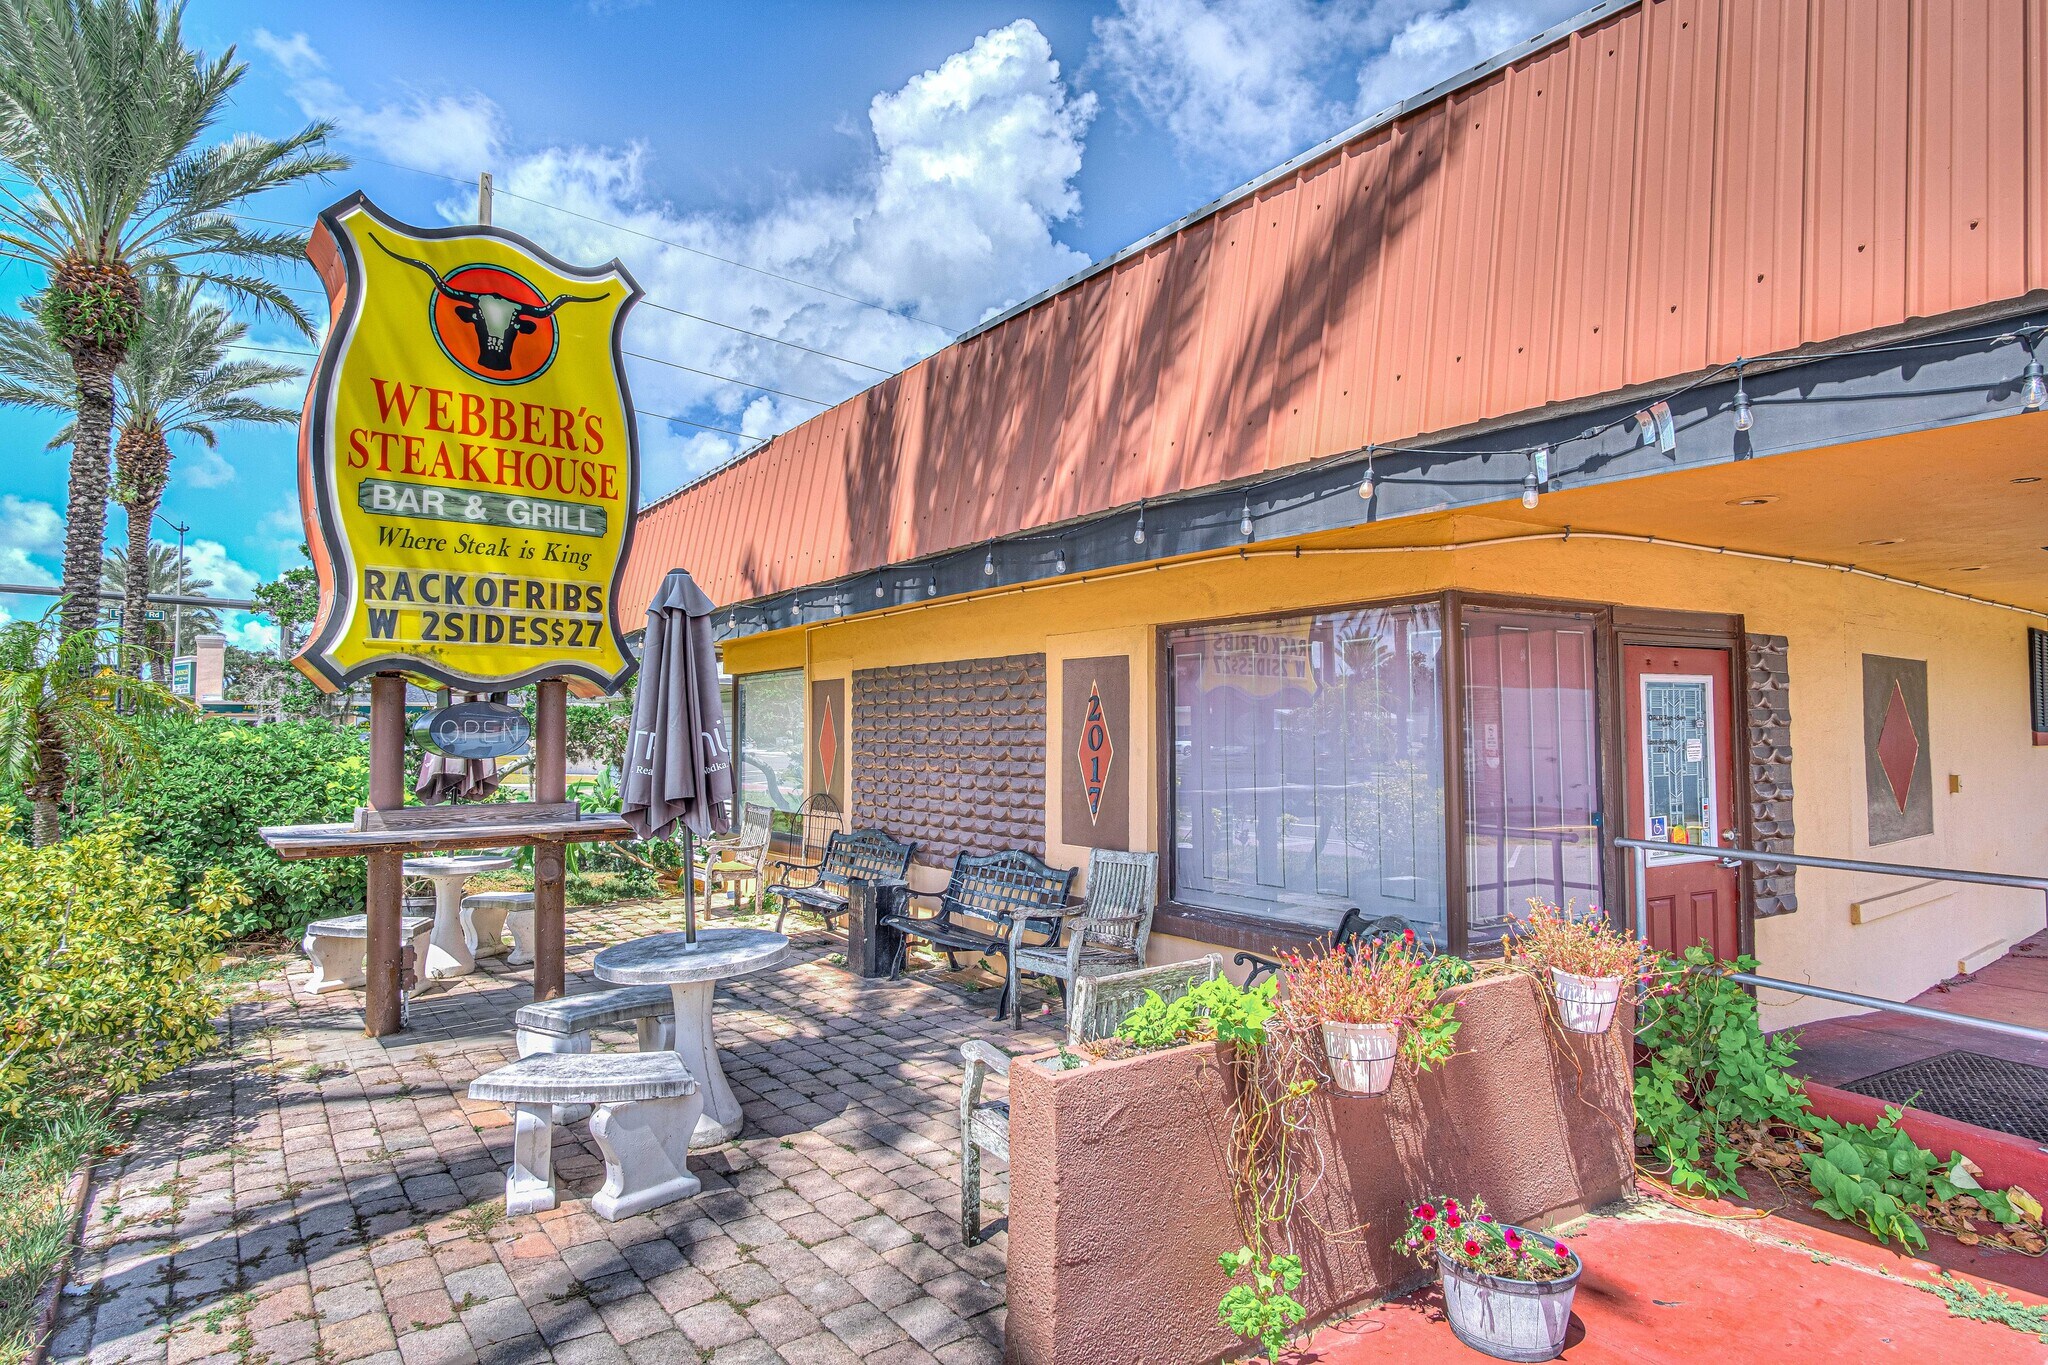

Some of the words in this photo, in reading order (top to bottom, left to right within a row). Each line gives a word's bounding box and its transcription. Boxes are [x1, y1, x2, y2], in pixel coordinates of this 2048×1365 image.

[370, 377, 604, 455] WEBBER'S
[347, 427, 619, 500] STEAKHOUSE
[373, 484, 444, 516] BAR
[464, 495, 487, 520] &
[506, 499, 596, 533] GRILL
[378, 525, 447, 552] Where
[453, 533, 511, 558] Steak
[519, 539, 535, 559] is
[542, 542, 592, 571] King
[367, 608, 399, 639] W
[440, 718, 519, 744] OPEN
[635, 765, 653, 776] Rea
[1087, 695, 1104, 815] 2017
